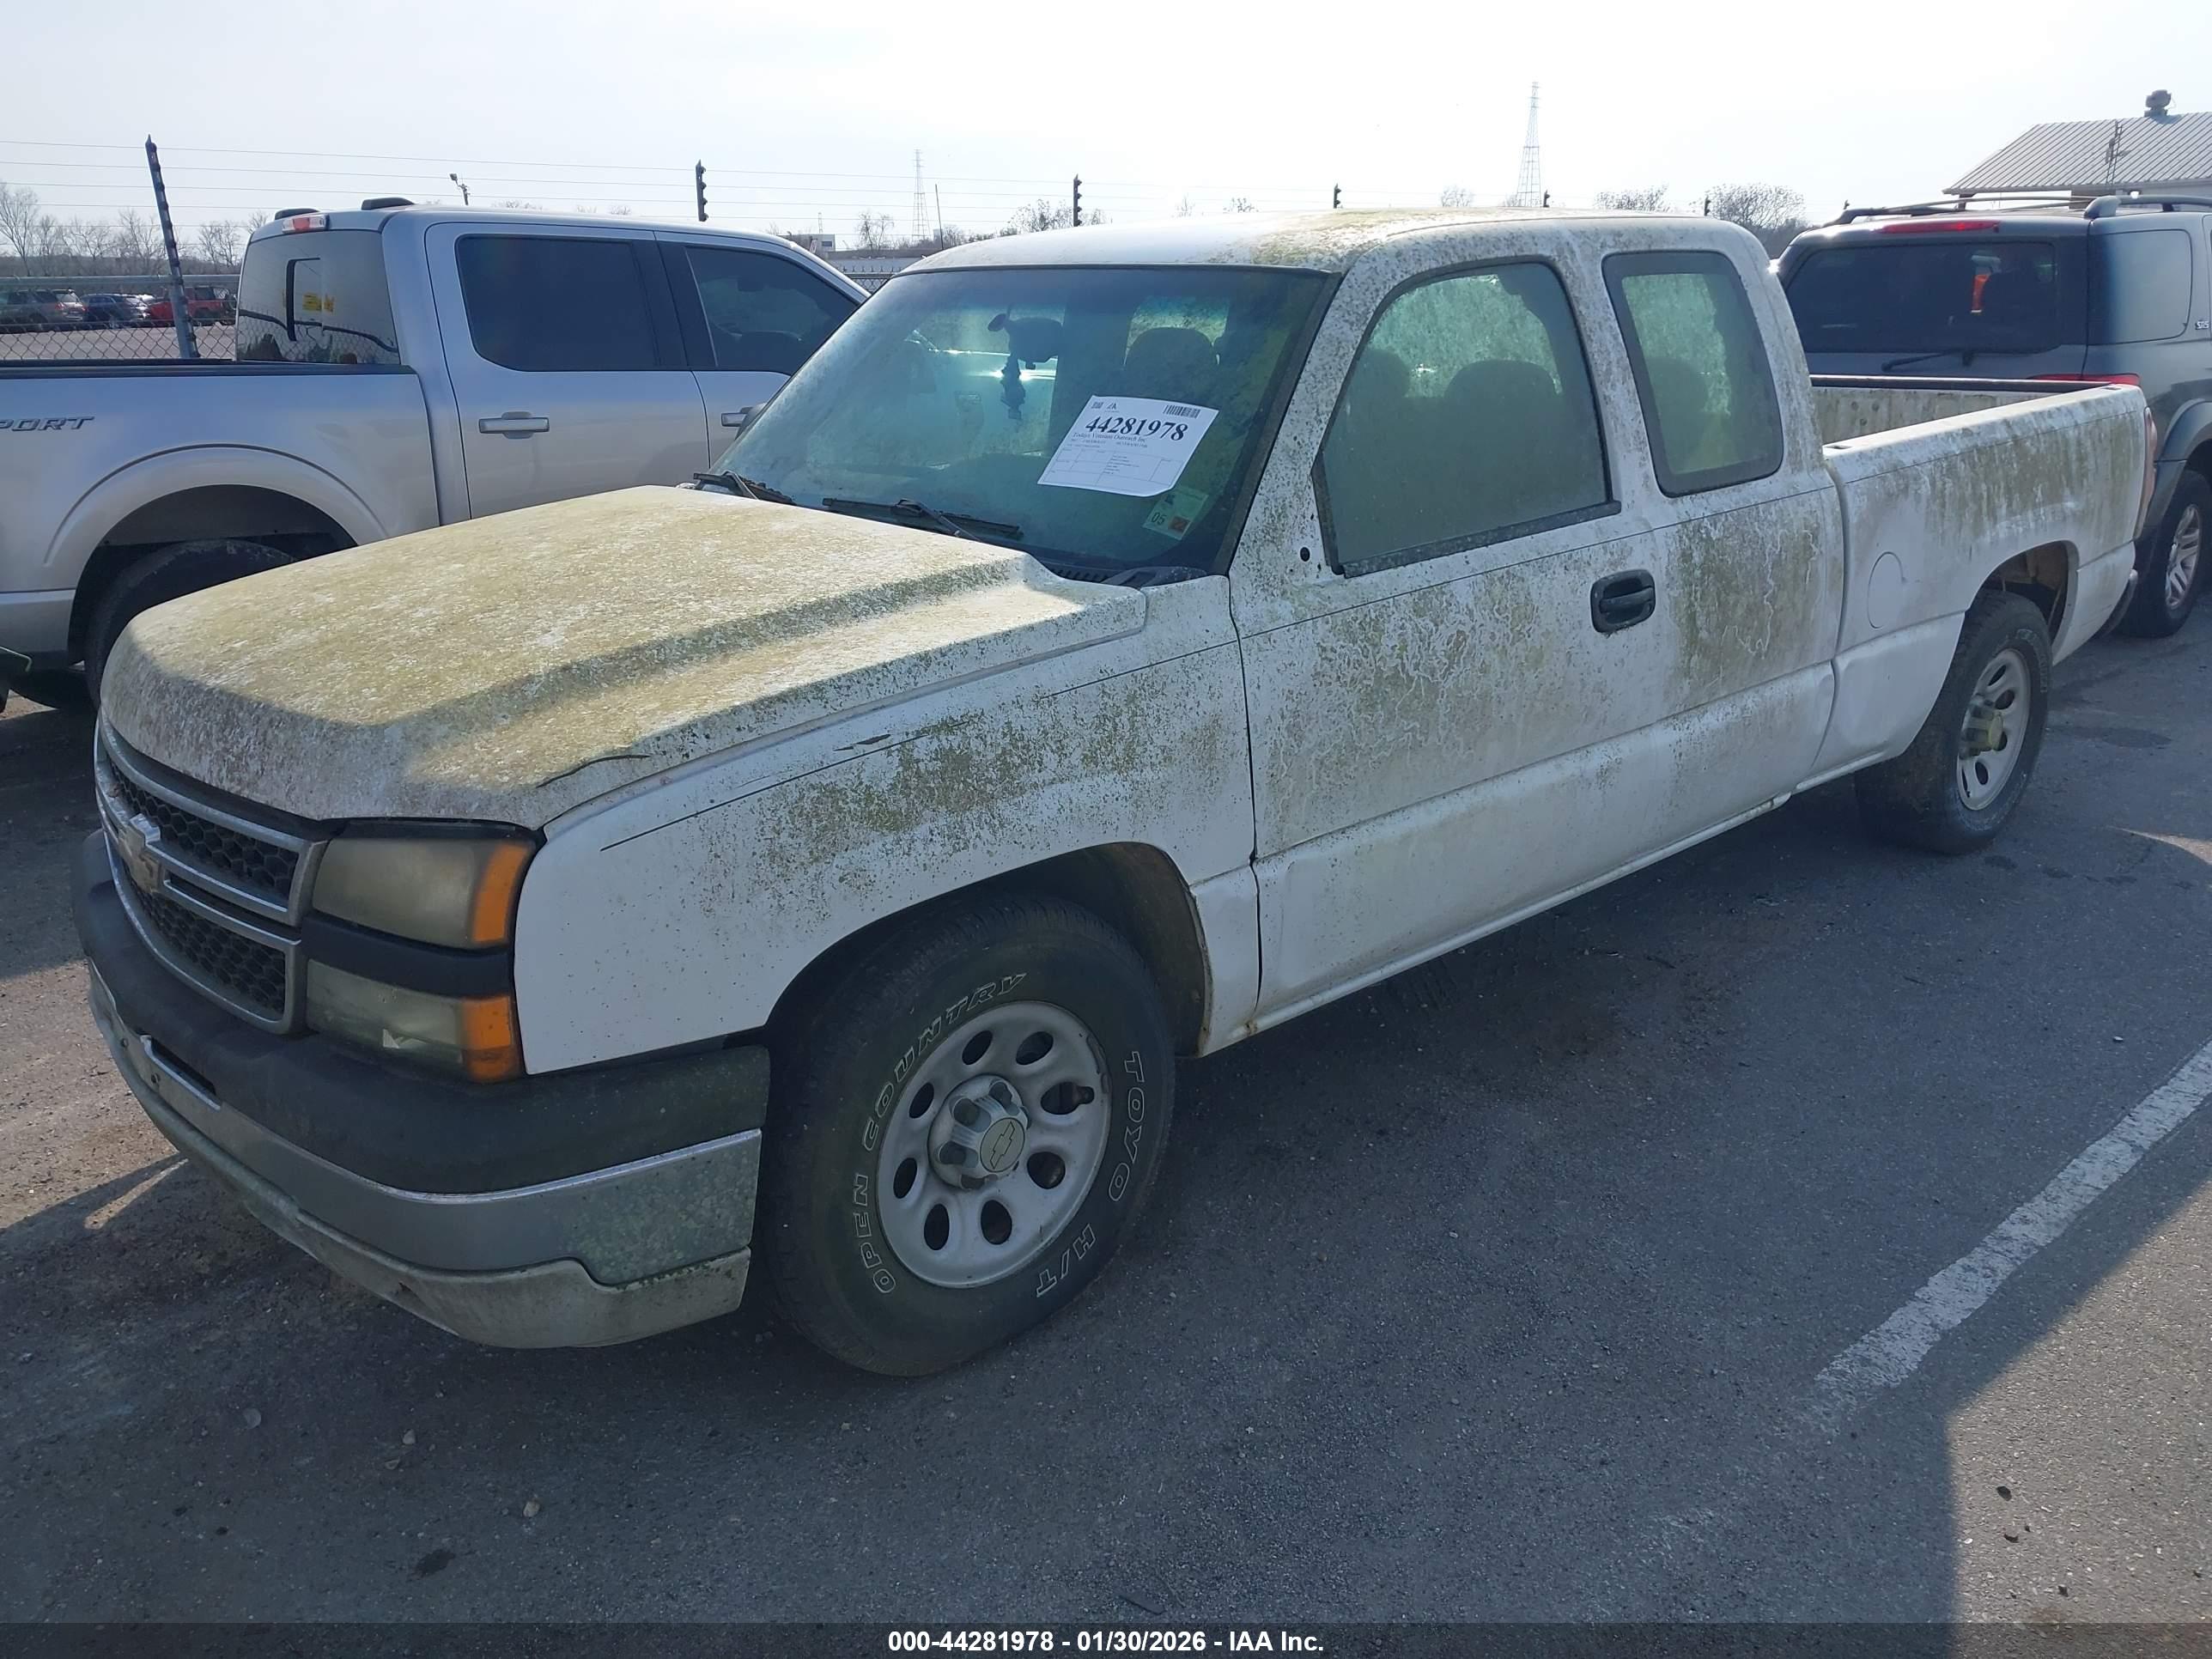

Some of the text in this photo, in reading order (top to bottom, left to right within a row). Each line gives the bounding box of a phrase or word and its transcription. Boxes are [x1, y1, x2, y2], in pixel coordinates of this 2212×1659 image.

[1085, 416, 1188, 441] 44281978
[853, 973, 1027, 1293] OPEN COUNTRY
[1108, 1051, 1146, 1201] TOYO
[1036, 1224, 1096, 1297] H/T
